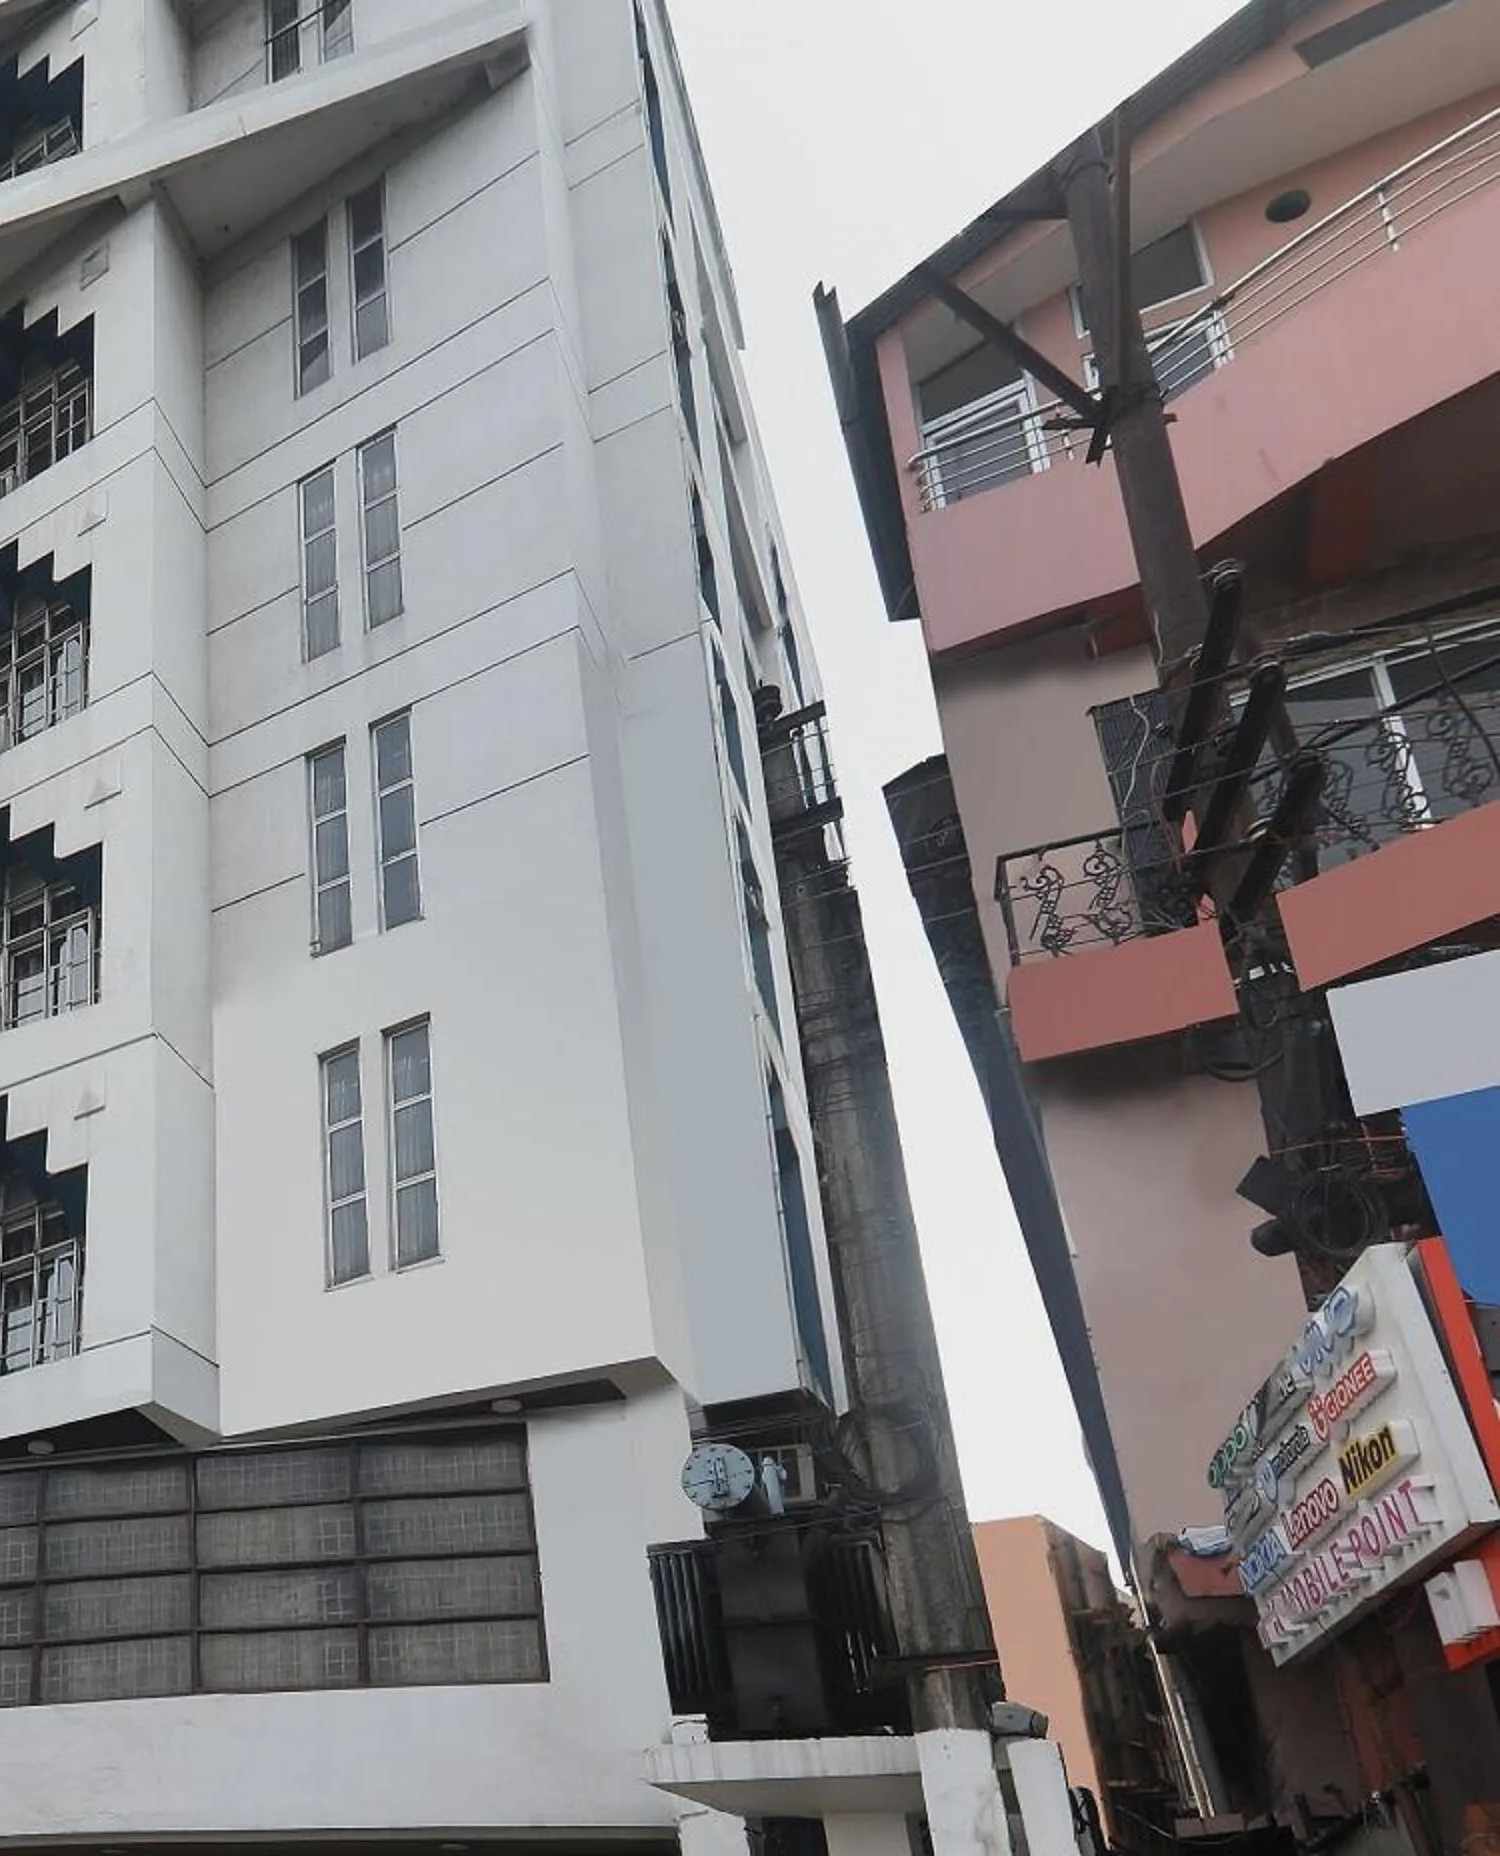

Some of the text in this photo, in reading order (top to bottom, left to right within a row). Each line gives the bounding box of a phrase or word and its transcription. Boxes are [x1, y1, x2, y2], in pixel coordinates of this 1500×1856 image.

[1323, 1352, 1377, 1424] GIONEE
[1279, 1477, 1340, 1552] Lenovo
[1338, 1425, 1396, 1494] Nikon
[1280, 1541, 1350, 1613] MOBILE
[1347, 1480, 1421, 1567] POINT
